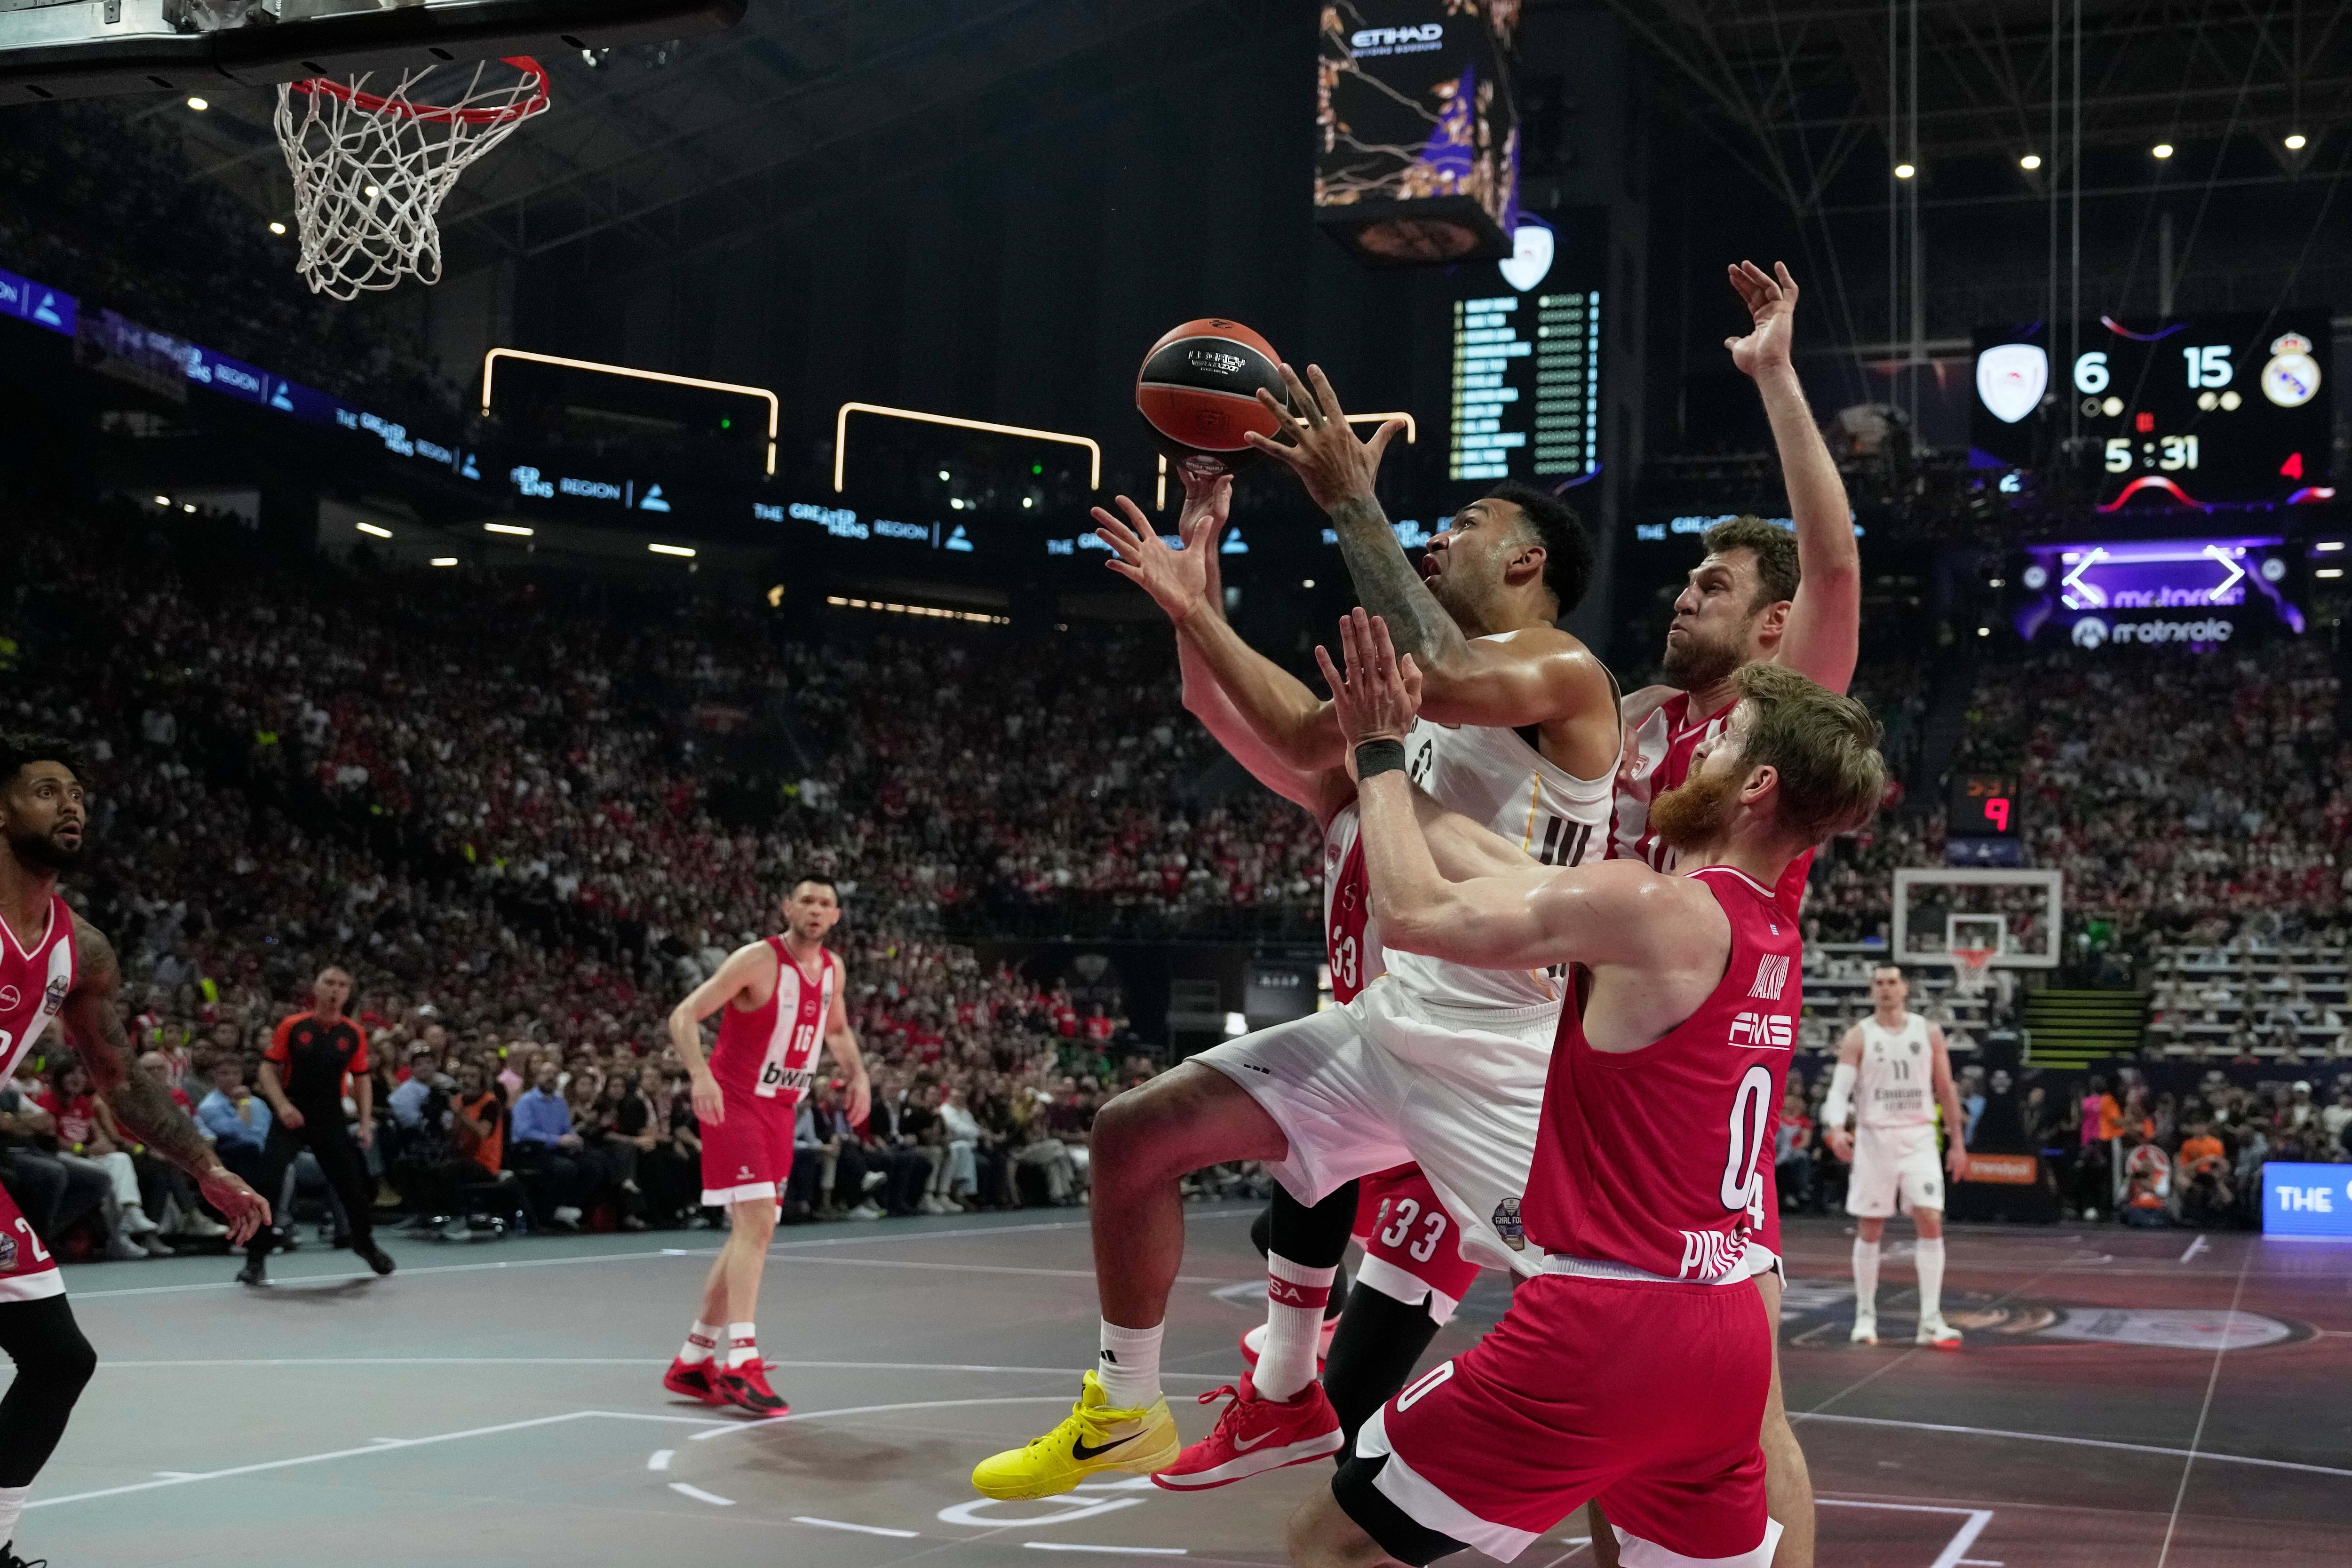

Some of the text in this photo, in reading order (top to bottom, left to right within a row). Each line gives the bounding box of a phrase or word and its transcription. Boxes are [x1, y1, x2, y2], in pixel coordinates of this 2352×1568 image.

[1351, 24, 1443, 48] ETIHAD
[2074, 351, 2110, 394] 6
[2183, 345, 2233, 389] 15
[2105, 435, 2199, 474] 5:31
[2280, 452, 2304, 481] 4
[1984, 798, 2010, 832] 9
[794, 1023, 815, 1053] 16
[1728, 1012, 1792, 1045] FMS
[1891, 1059, 1910, 1080] 11
[1720, 1064, 1772, 1212] 0
[2275, 1186, 2334, 1212] THE
[1381, 1198, 1447, 1263] 33
[1396, 1360, 1455, 1413] 0
